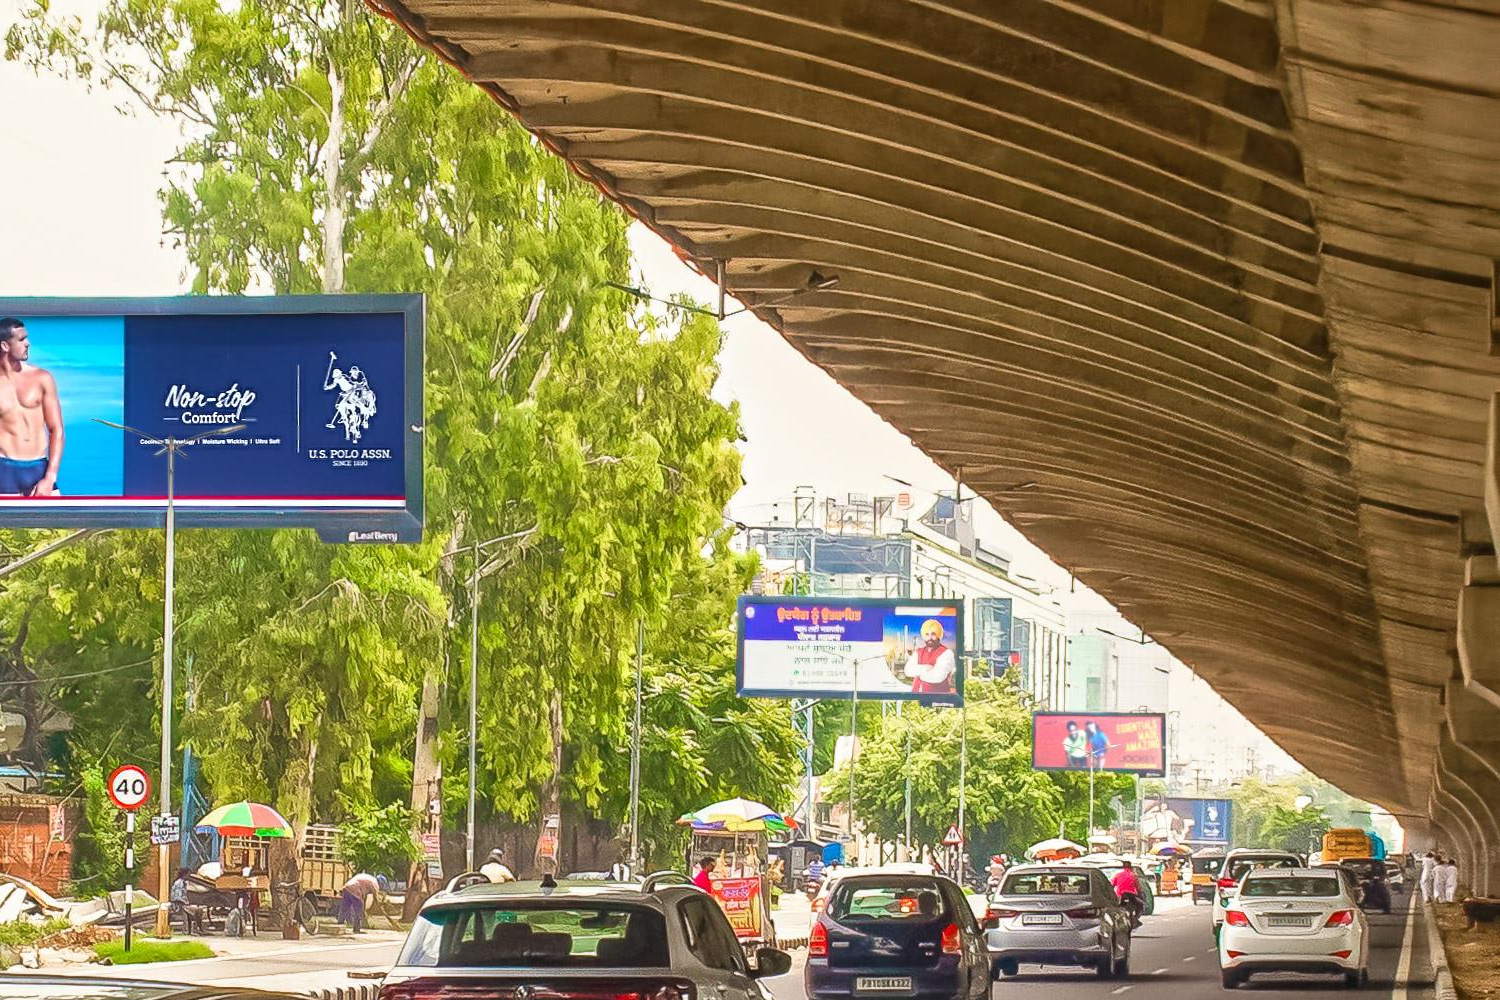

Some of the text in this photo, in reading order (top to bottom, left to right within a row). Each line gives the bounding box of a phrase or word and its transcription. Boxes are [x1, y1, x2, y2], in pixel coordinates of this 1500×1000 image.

[164, 383, 256, 420] Non-stop
[181, 411, 237, 424] Comfort
[226, 438, 248, 446] Wicking
[308, 449, 393, 459] U.S. POLO ASSN.
[116, 779, 145, 795] 40
